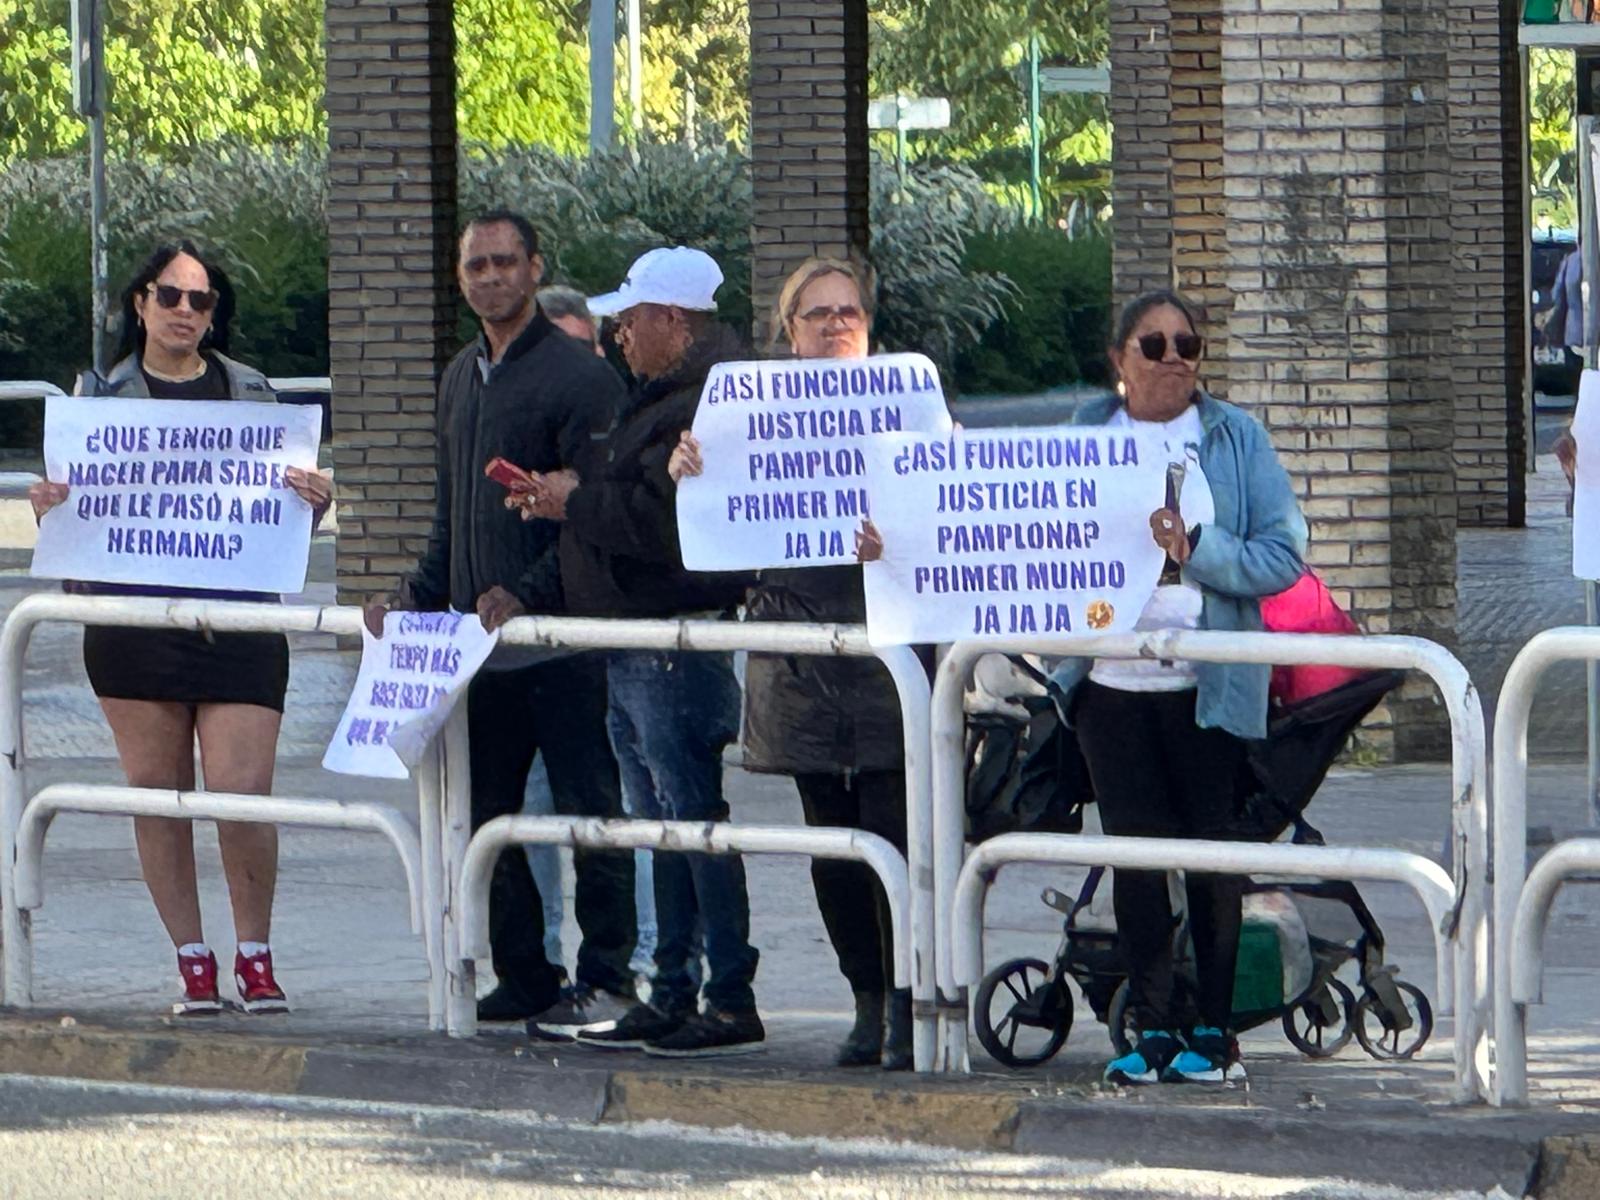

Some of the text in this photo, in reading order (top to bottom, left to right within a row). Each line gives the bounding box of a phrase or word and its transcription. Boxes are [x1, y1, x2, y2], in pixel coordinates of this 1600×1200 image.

[772, 367, 904, 400] FUNCIONA
[910, 366, 936, 392] LA
[157, 427, 233, 451] TENGO
[239, 425, 286, 453] QUE
[748, 406, 902, 440] JUSTICIA EN
[749, 448, 866, 482] PAMPLON
[965, 438, 1101, 469] FUNCIONA
[1109, 437, 1139, 466] LA
[151, 460, 213, 485] PARA
[219, 458, 288, 489] SABE
[77, 494, 122, 520] QUE
[128, 492, 152, 519] LE
[228, 497, 244, 524] A
[251, 498, 281, 526] MI
[727, 488, 870, 522] PRIMER MU
[937, 477, 1097, 512] JUSTICIA EN
[107, 527, 243, 560] HERMANA?
[784, 531, 810, 559] JA
[818, 530, 845, 557] JA
[937, 519, 1100, 553] PAMPLONA?
[915, 560, 1125, 593] PRIMER MUNDO
[973, 603, 1072, 634] JA JA JA
